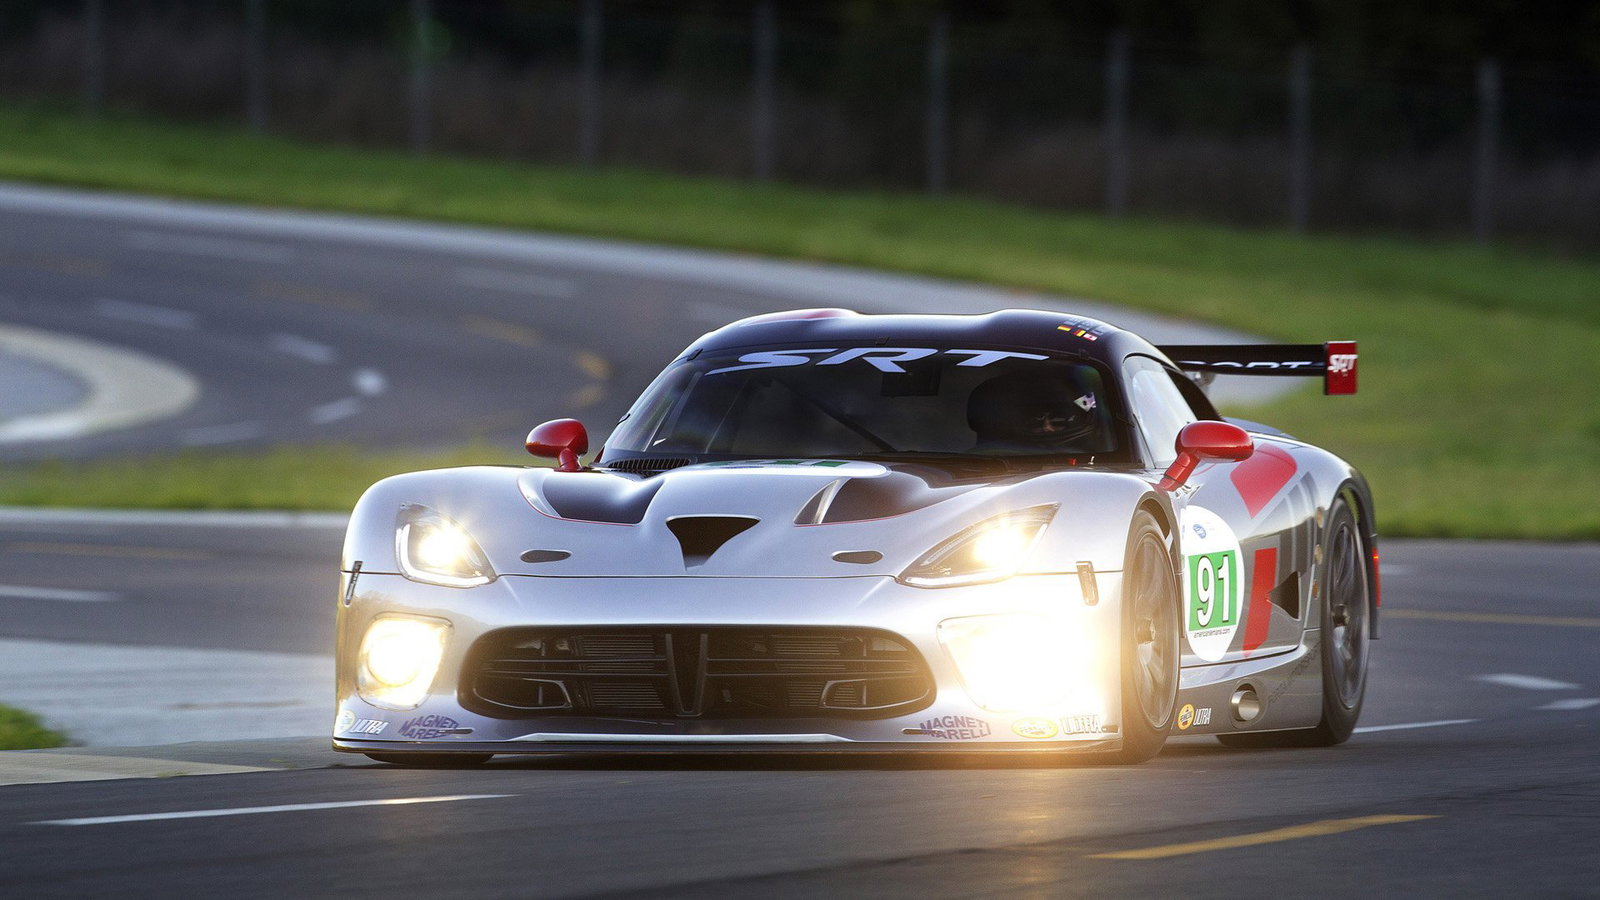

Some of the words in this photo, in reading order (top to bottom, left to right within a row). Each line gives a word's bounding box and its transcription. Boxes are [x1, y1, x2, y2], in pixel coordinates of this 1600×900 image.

[704, 347, 1050, 376] SRT
[1327, 354, 1359, 373] SRT
[1196, 554, 1230, 628] 91
[920, 715, 992, 731] MAGNETI
[1193, 708, 1212, 725] ULTRA
[349, 718, 389, 735] ULTRA
